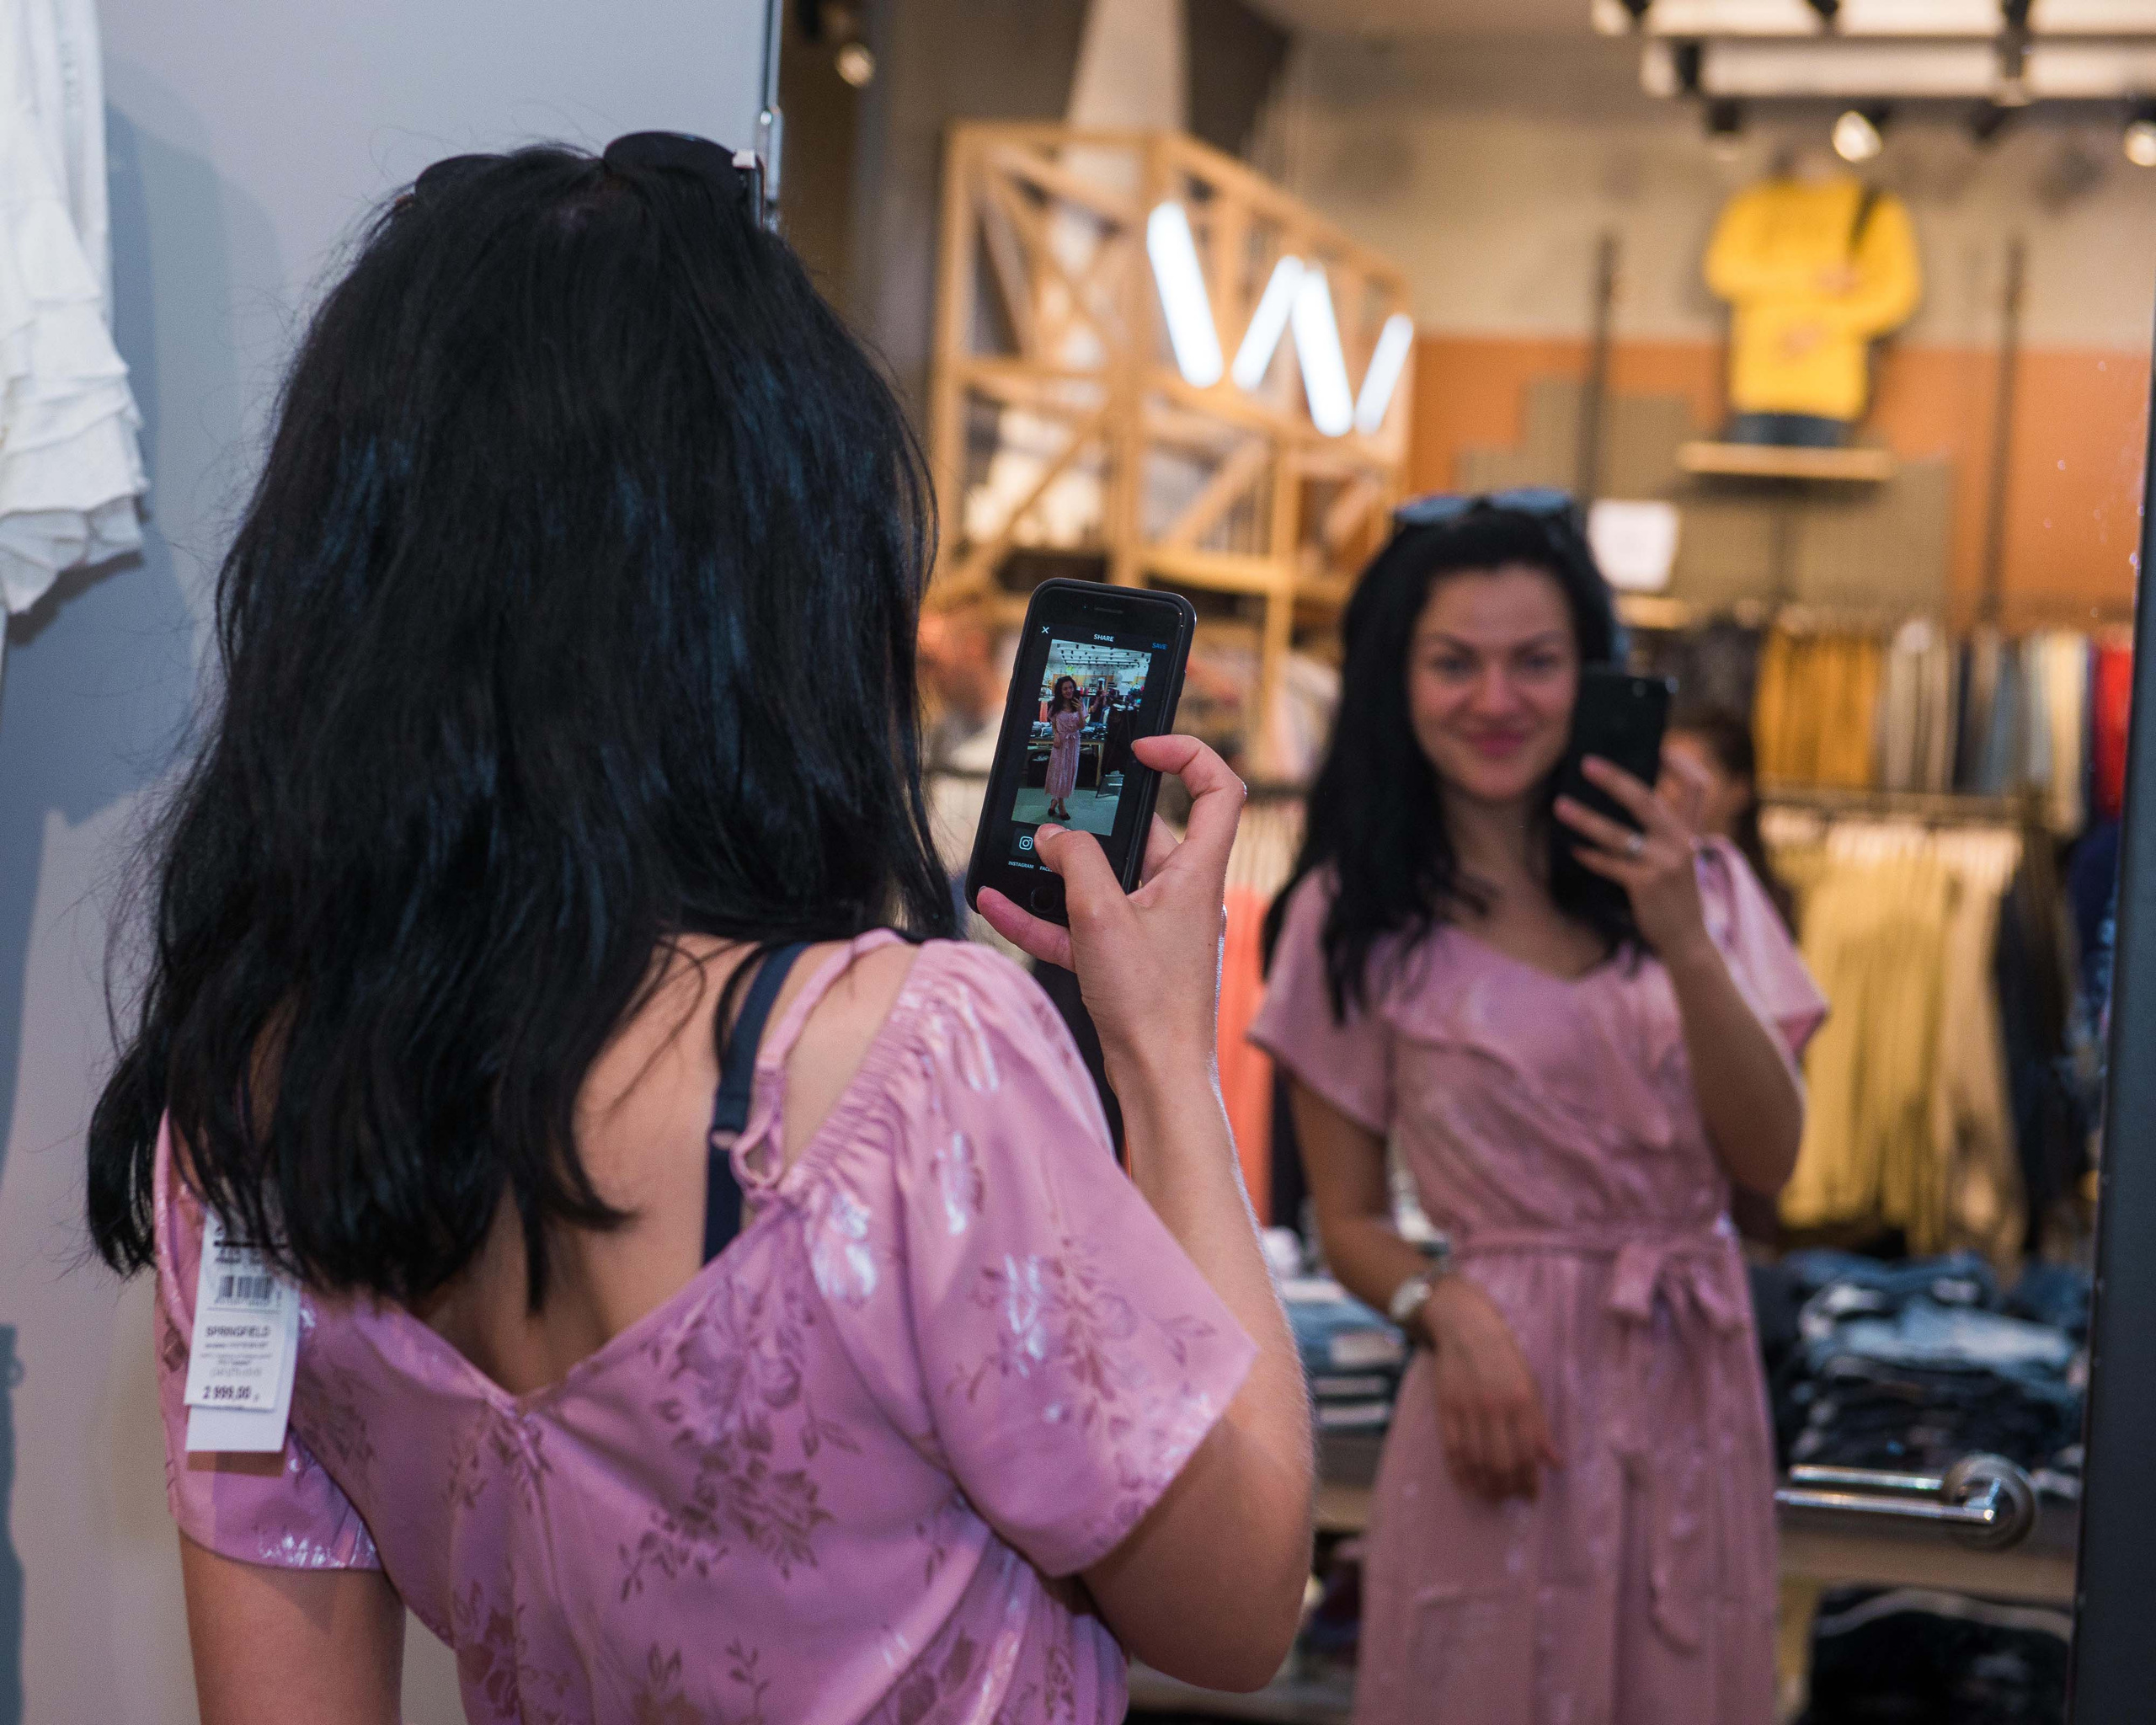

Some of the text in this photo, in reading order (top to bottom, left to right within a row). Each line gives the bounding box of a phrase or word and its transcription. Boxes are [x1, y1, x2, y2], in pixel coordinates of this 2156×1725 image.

[1093, 633, 1114, 643] SHARE
[1151, 642, 1168, 650] SAVE
[1008, 860, 1034, 869] INSTAGRAM
[205, 1325, 271, 1338] SPRINGFIELD
